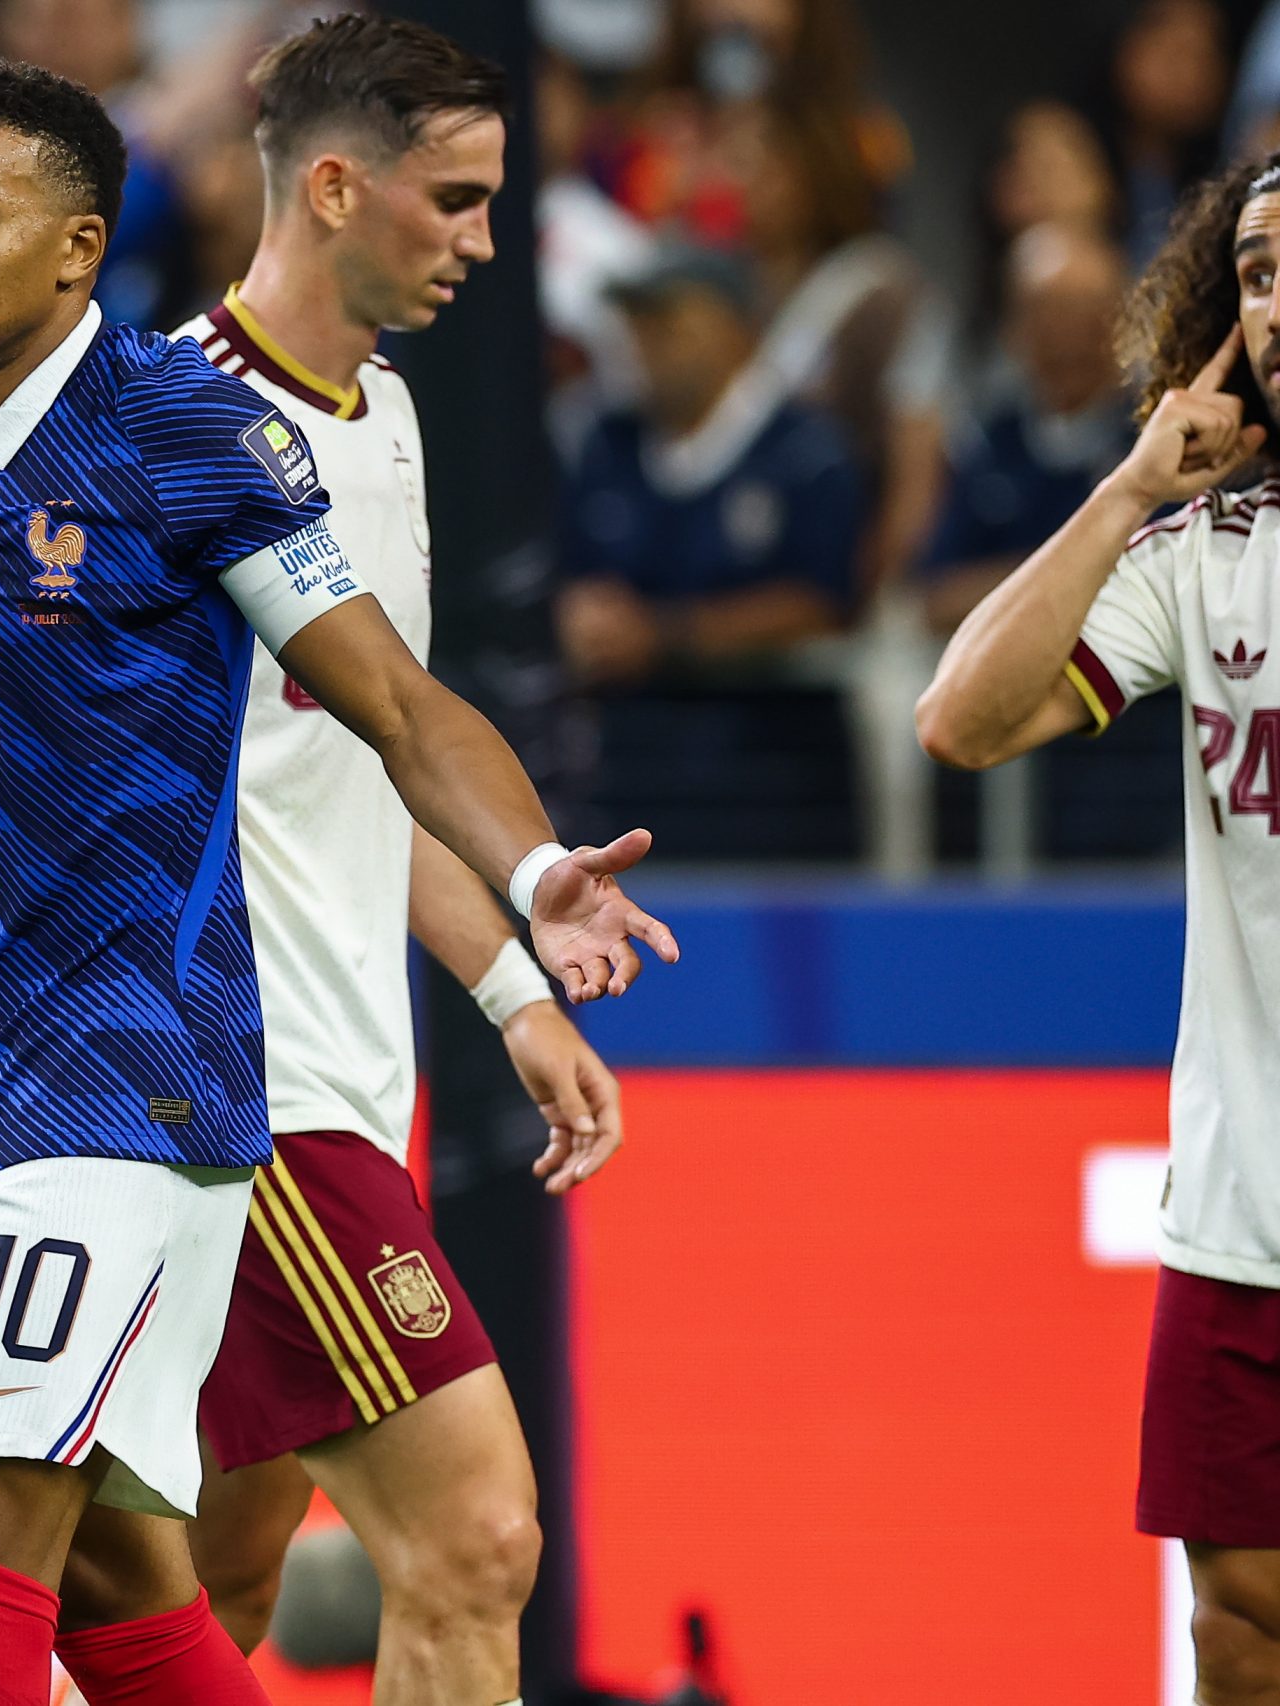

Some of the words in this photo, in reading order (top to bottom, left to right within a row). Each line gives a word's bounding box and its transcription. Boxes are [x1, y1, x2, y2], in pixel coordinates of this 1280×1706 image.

[272, 516, 328, 556] FOOTBALL
[279, 533, 340, 575] UNITES
[290, 574, 322, 596] the
[318, 554, 351, 580] World
[329, 579, 355, 595] FIFA
